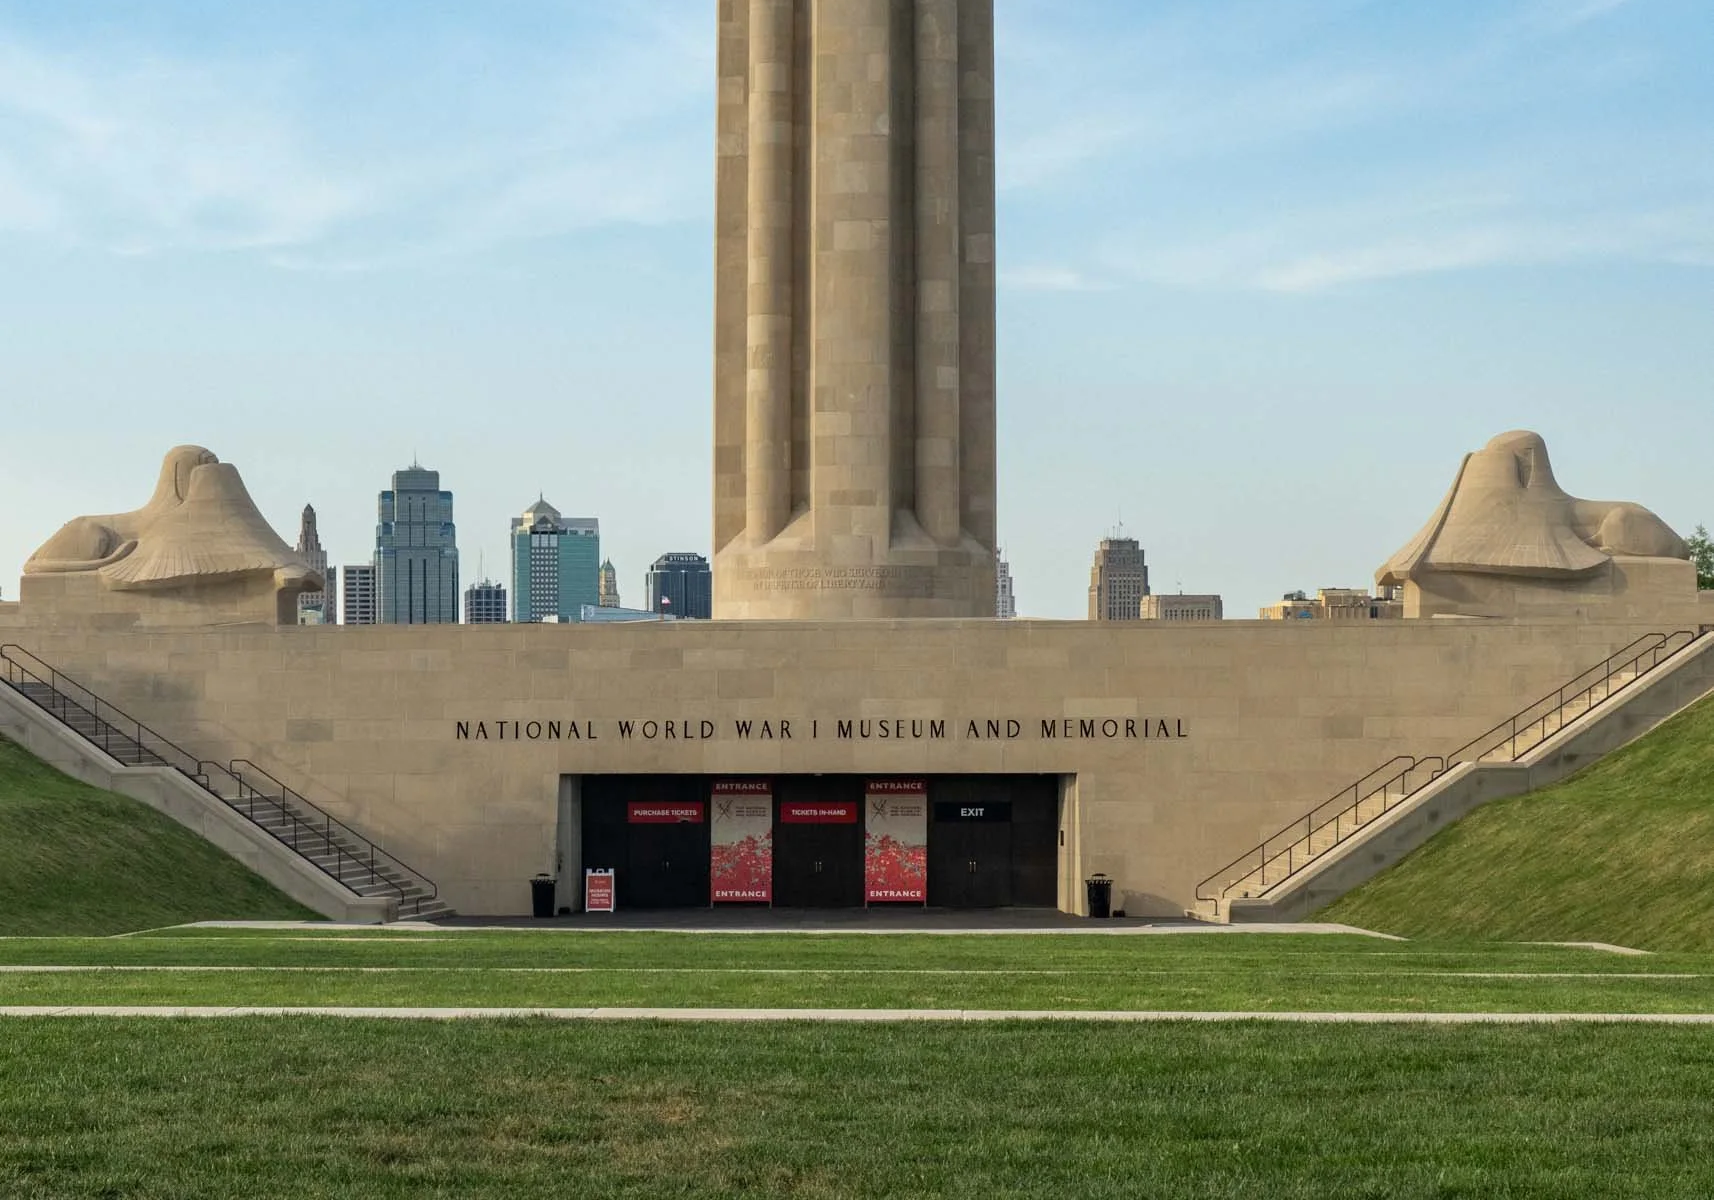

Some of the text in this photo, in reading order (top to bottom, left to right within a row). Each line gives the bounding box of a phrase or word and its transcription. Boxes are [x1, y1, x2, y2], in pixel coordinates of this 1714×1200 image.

[456, 719, 1188, 740] NATIONAL WORLD WAR I MUSEUM AND MEMORIAL
[869, 782, 922, 790] ENTRANCE
[960, 807, 985, 817] EXIT
[715, 890, 767, 898] ENTRANCE
[869, 890, 922, 898] ENTRANCE
